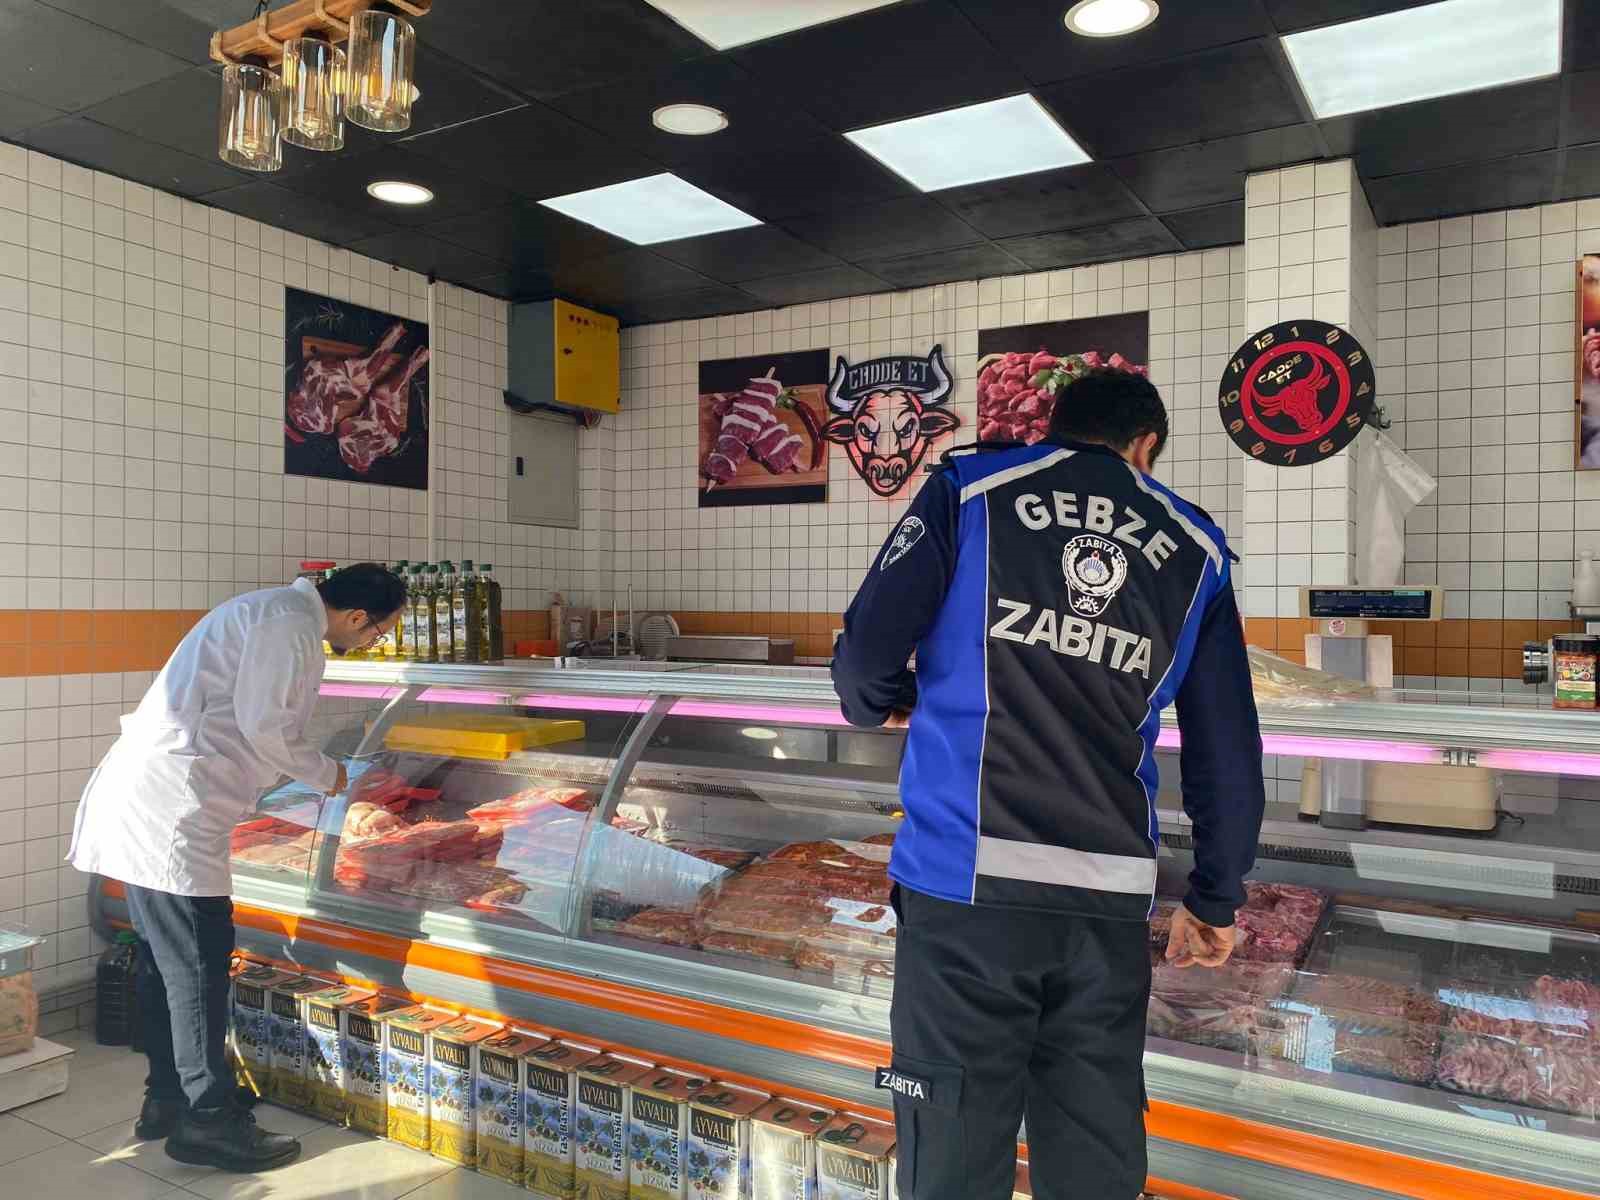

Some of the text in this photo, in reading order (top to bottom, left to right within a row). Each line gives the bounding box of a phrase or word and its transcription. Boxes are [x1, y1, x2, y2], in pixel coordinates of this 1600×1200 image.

[1290, 326, 1300, 338] 1
[1325, 329, 1342, 345] 2
[1253, 333, 1275, 350] 12
[1231, 358, 1246, 373] 11
[1347, 351, 1363, 367] 3
[907, 362, 929, 382] ET
[1257, 354, 1303, 384] CADDE
[1356, 382, 1371, 396] 4
[1220, 390, 1240, 407] 10
[1345, 413, 1361, 428] 5
[1283, 448, 1297, 463] 7
[1014, 490, 1179, 571] GEBZE
[1078, 538, 1115, 555] ZABITA
[989, 598, 1152, 680] ZABITA
[880, 1071, 924, 1099] ZABITA
